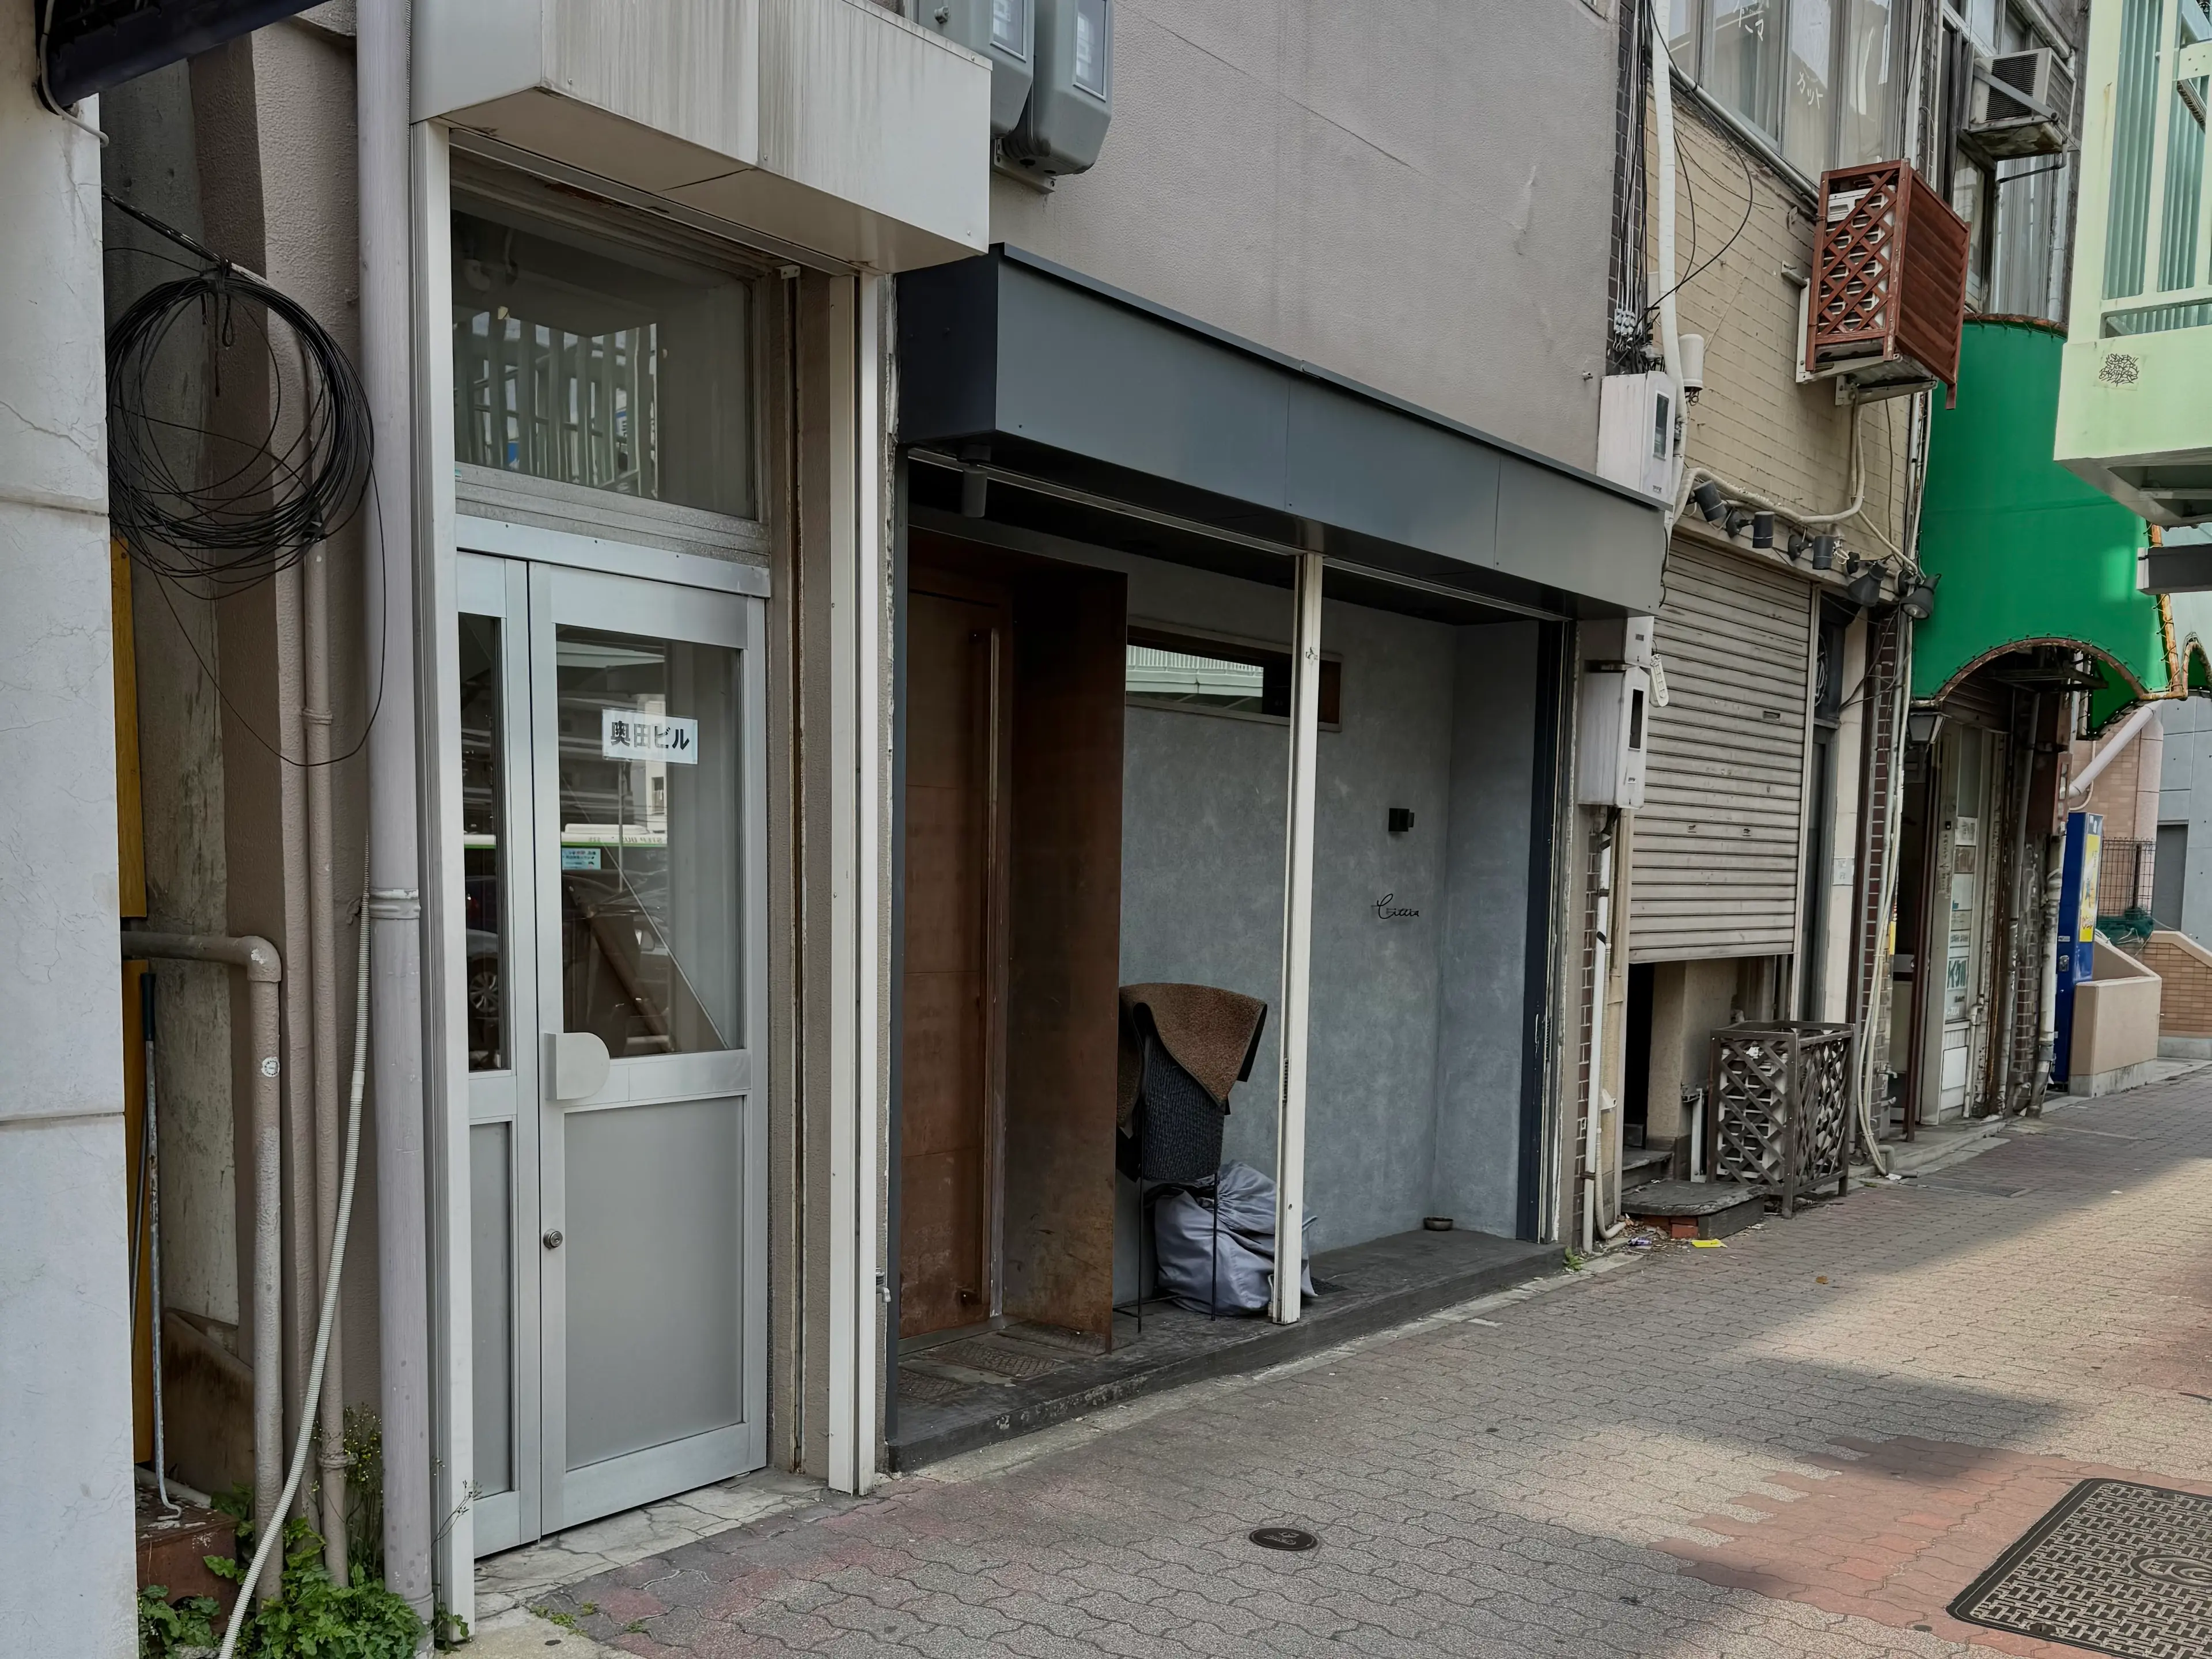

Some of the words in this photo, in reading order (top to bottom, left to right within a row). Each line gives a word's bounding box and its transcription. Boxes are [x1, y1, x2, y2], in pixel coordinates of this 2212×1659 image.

[1797, 71, 1824, 109] カット
[611, 721, 690, 750] 奥田ビル
